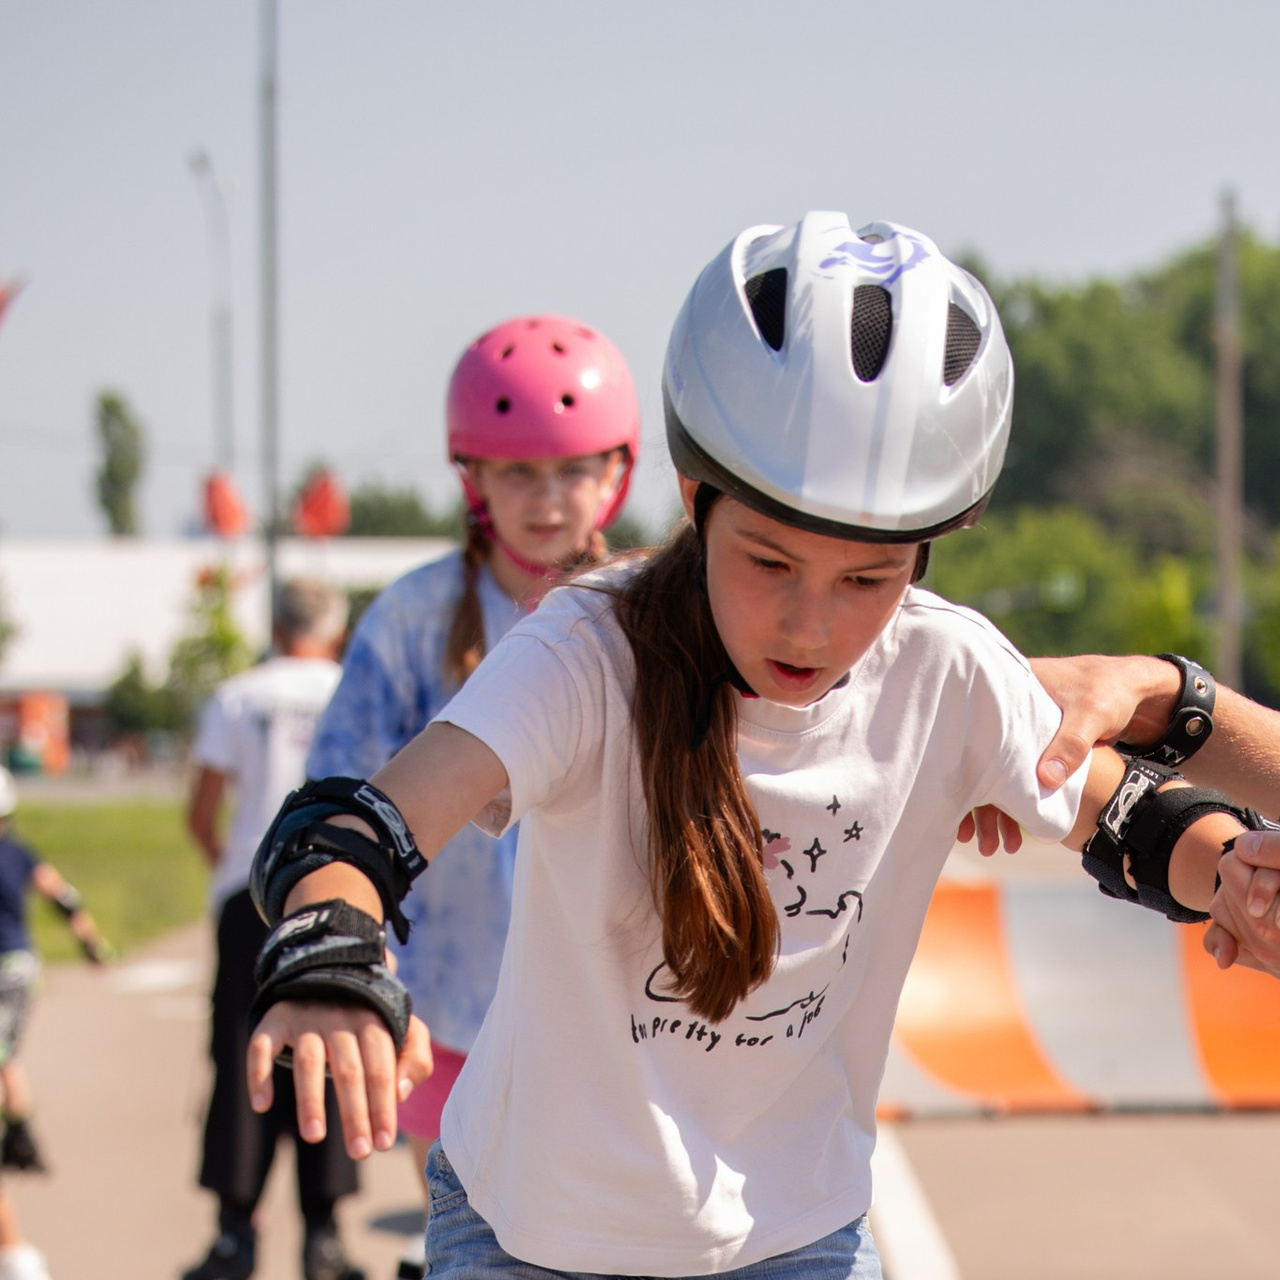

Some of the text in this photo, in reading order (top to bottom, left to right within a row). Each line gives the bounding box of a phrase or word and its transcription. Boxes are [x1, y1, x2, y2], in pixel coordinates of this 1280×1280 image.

[652, 1016, 721, 1052] pretty
[735, 1033, 774, 1047] for
[798, 995, 825, 1038] job
